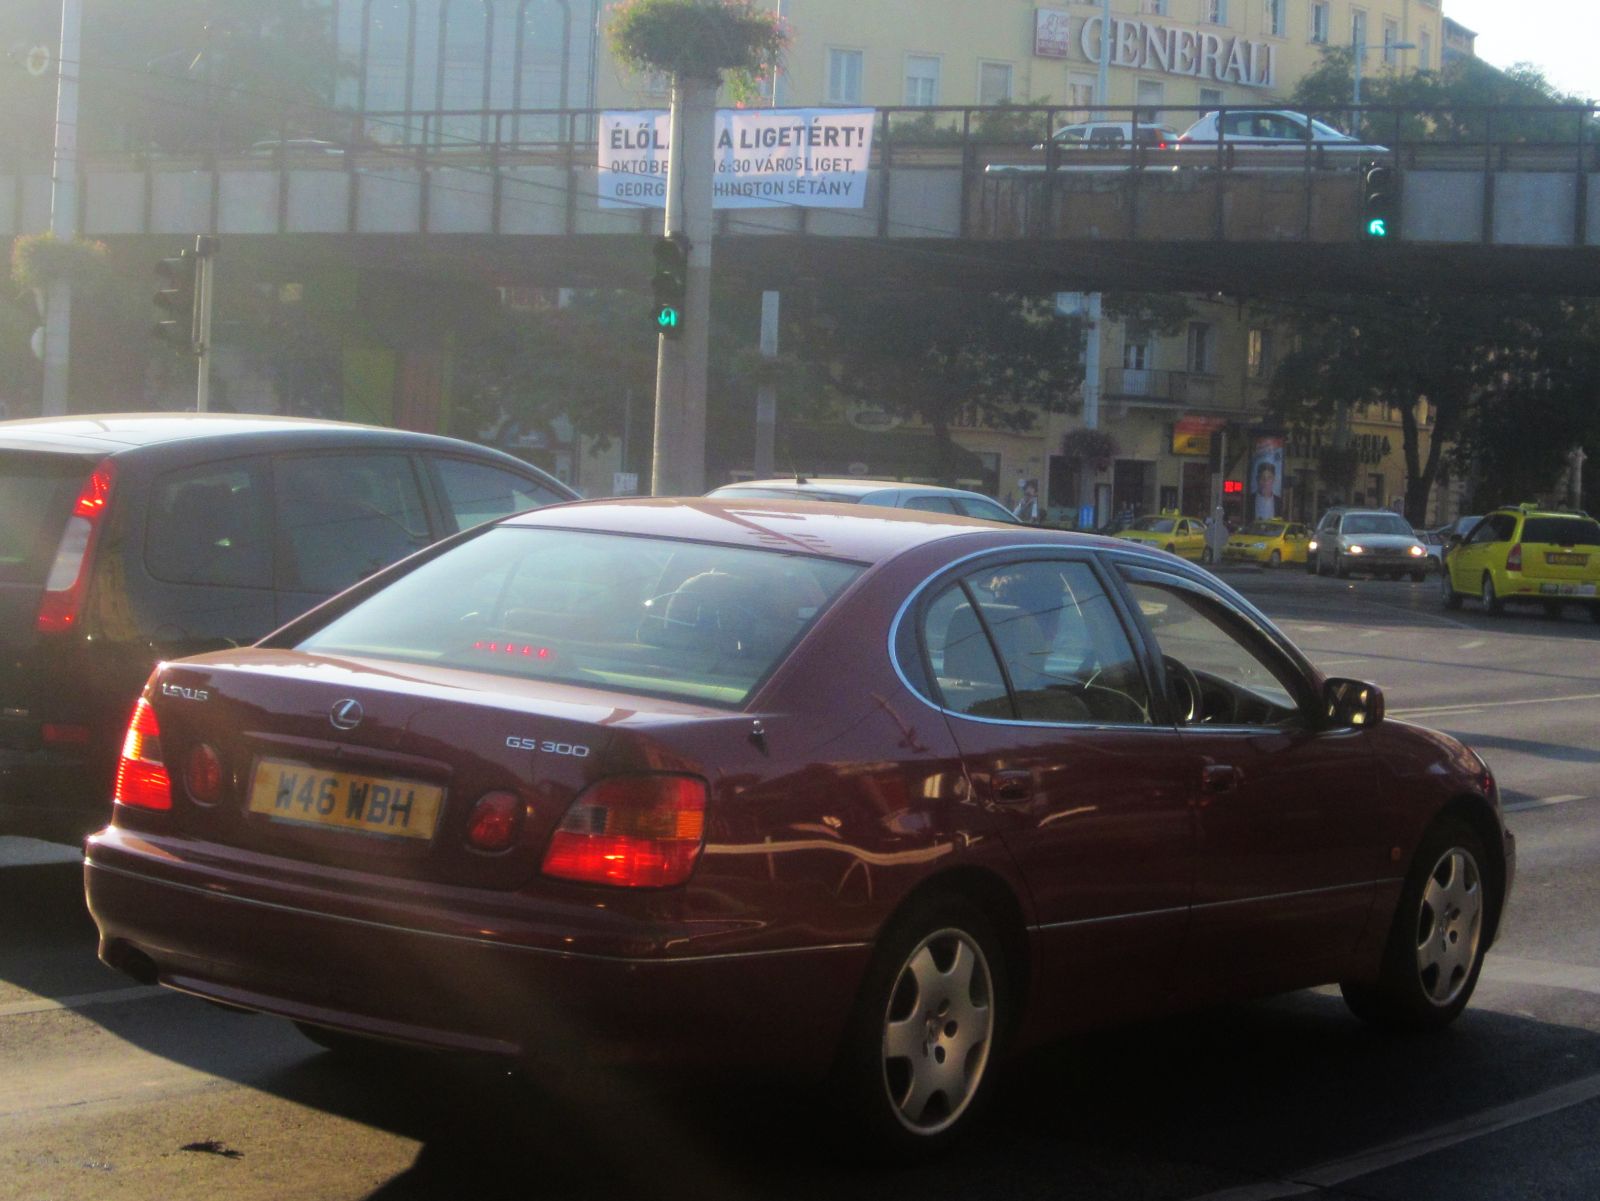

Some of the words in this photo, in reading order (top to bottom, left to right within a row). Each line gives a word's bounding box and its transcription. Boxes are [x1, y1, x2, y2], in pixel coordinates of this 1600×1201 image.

[1081, 16, 1279, 88] GENERALI
[611, 122, 669, 149] ÉLŐL
[717, 128, 733, 149] A
[740, 117, 864, 149] LIGETÉRT!
[611, 156, 668, 174] OKTÓBE
[755, 154, 855, 174] VÁROSLIGET,
[615, 182, 665, 196] GEORG
[714, 181, 784, 196] HINGTON
[162, 683, 208, 700] LEXUS
[505, 735, 536, 750] GS
[541, 740, 589, 757] 300
[275, 771, 339, 816] W46
[345, 781, 415, 829] WBH
